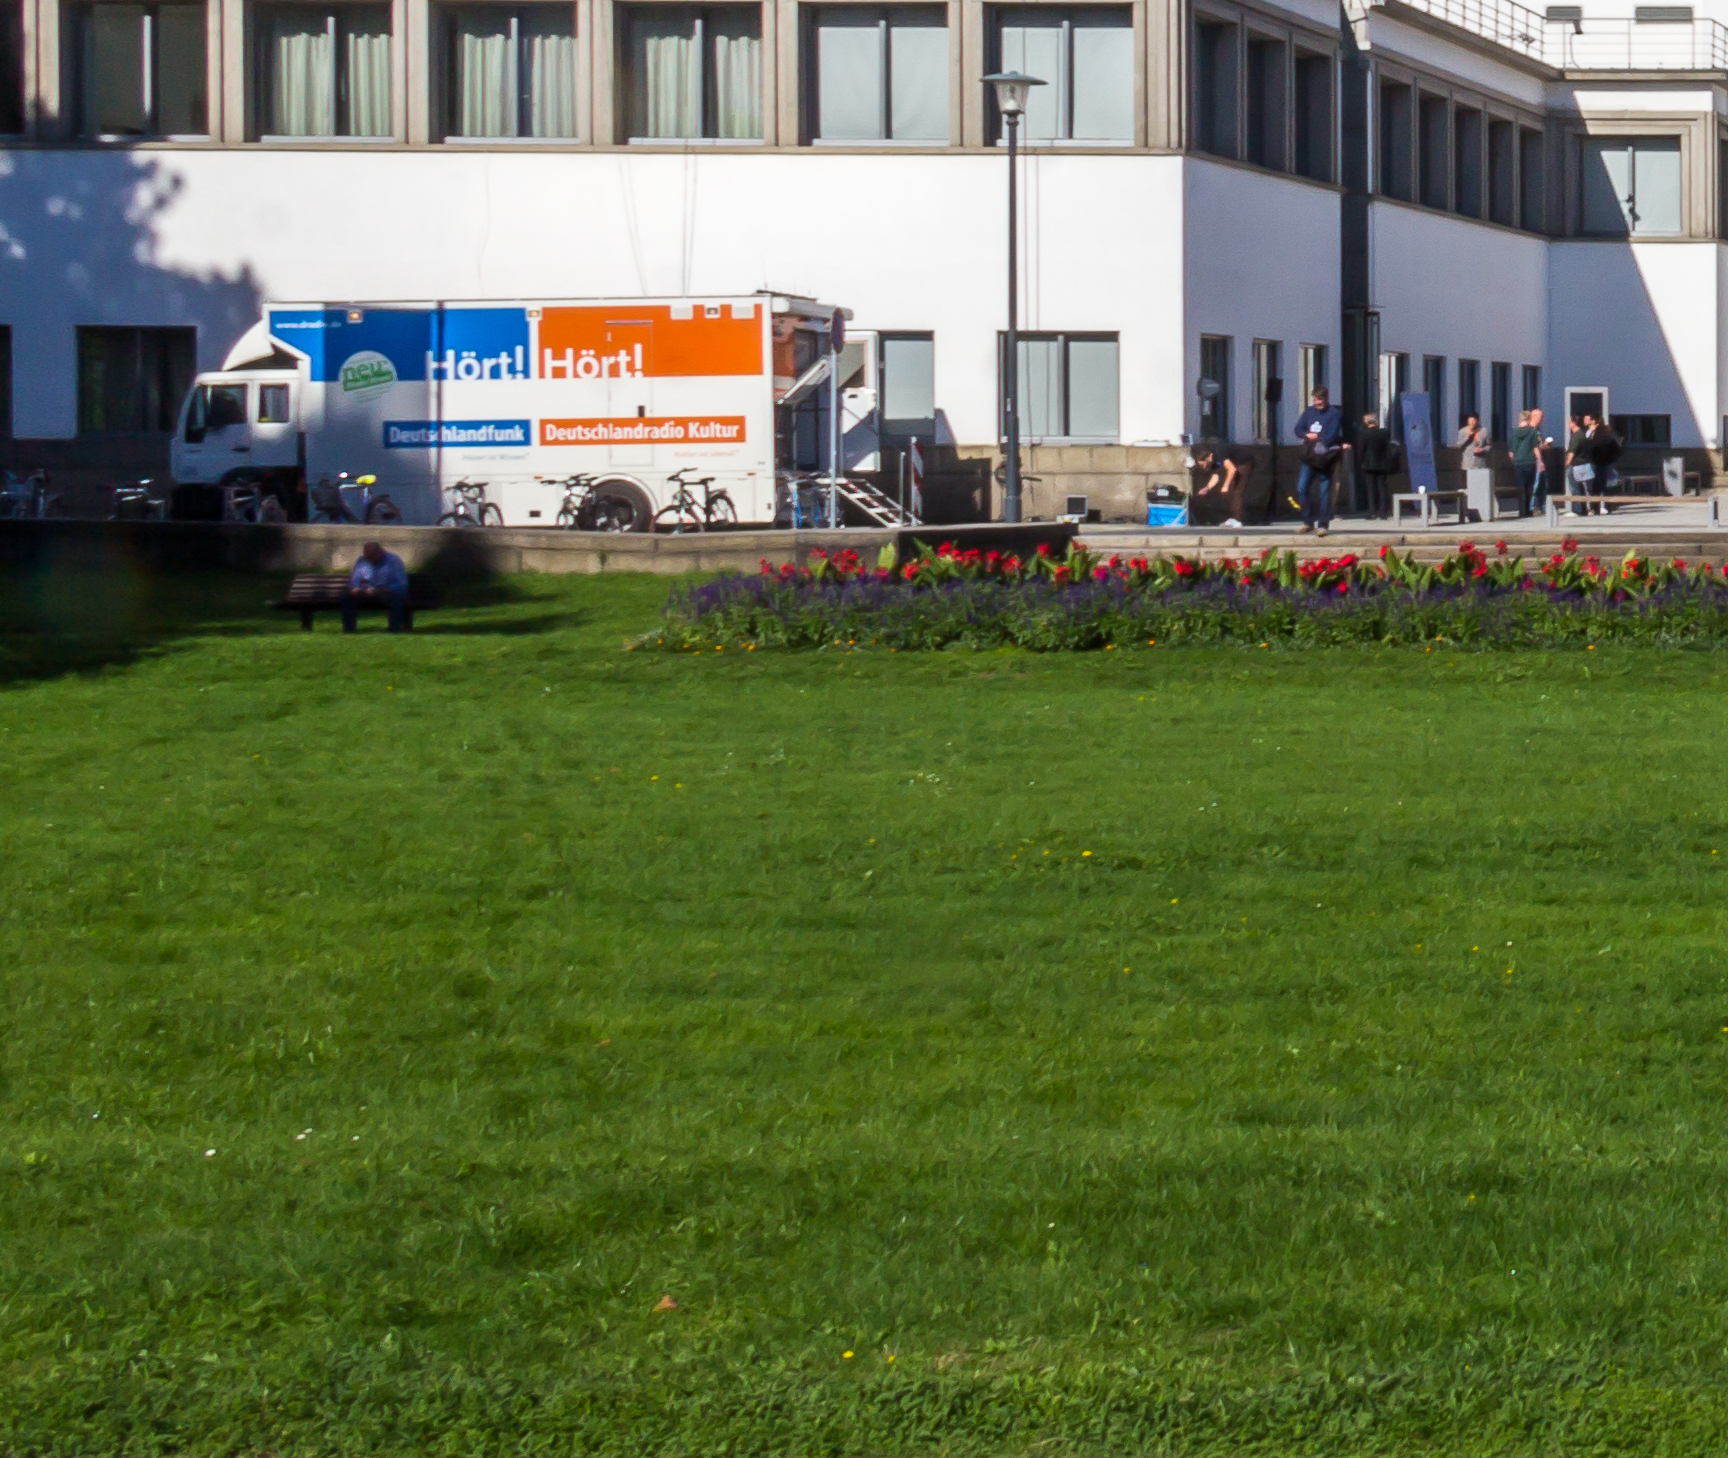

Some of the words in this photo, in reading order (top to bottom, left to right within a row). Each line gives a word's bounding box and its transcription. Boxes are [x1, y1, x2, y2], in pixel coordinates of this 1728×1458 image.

[425, 345, 524, 380] Hört!
[543, 343, 643, 378] Hört!
[545, 420, 684, 440] Deutschlandradio
[688, 421, 740, 439] Kultur
